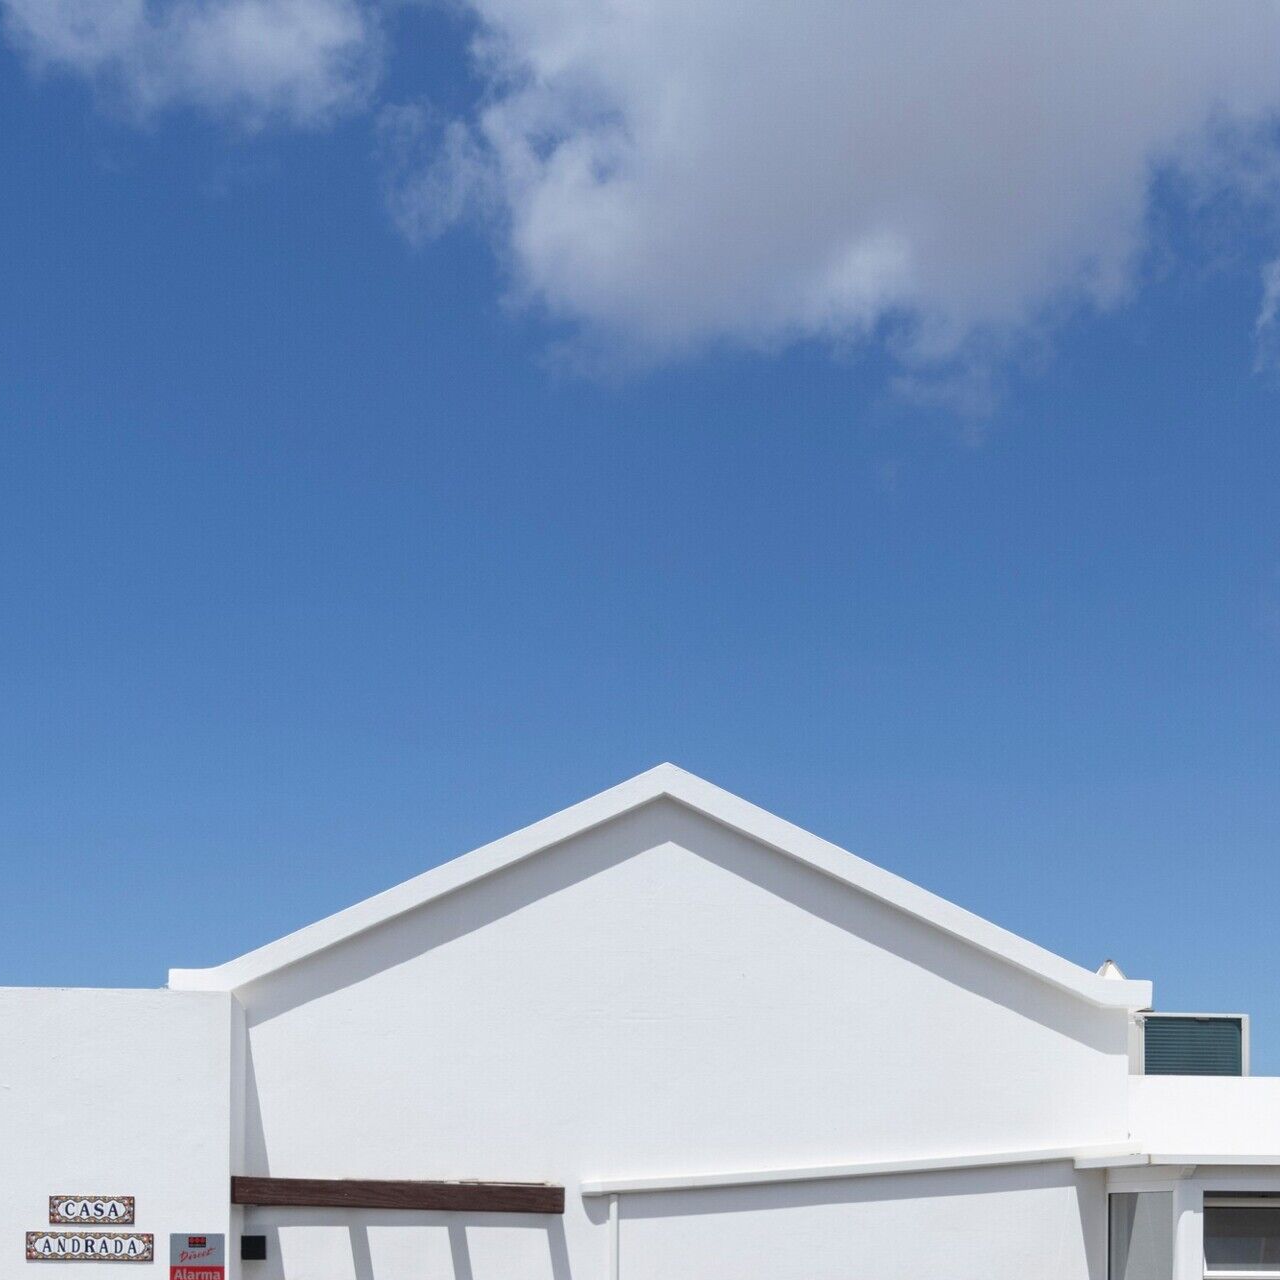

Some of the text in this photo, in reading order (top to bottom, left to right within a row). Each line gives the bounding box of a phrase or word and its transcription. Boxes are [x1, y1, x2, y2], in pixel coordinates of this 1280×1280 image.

[65, 1202, 118, 1217] CASA
[42, 1238, 137, 1254] ANDRADA
[173, 1269, 221, 1280] Alarma
